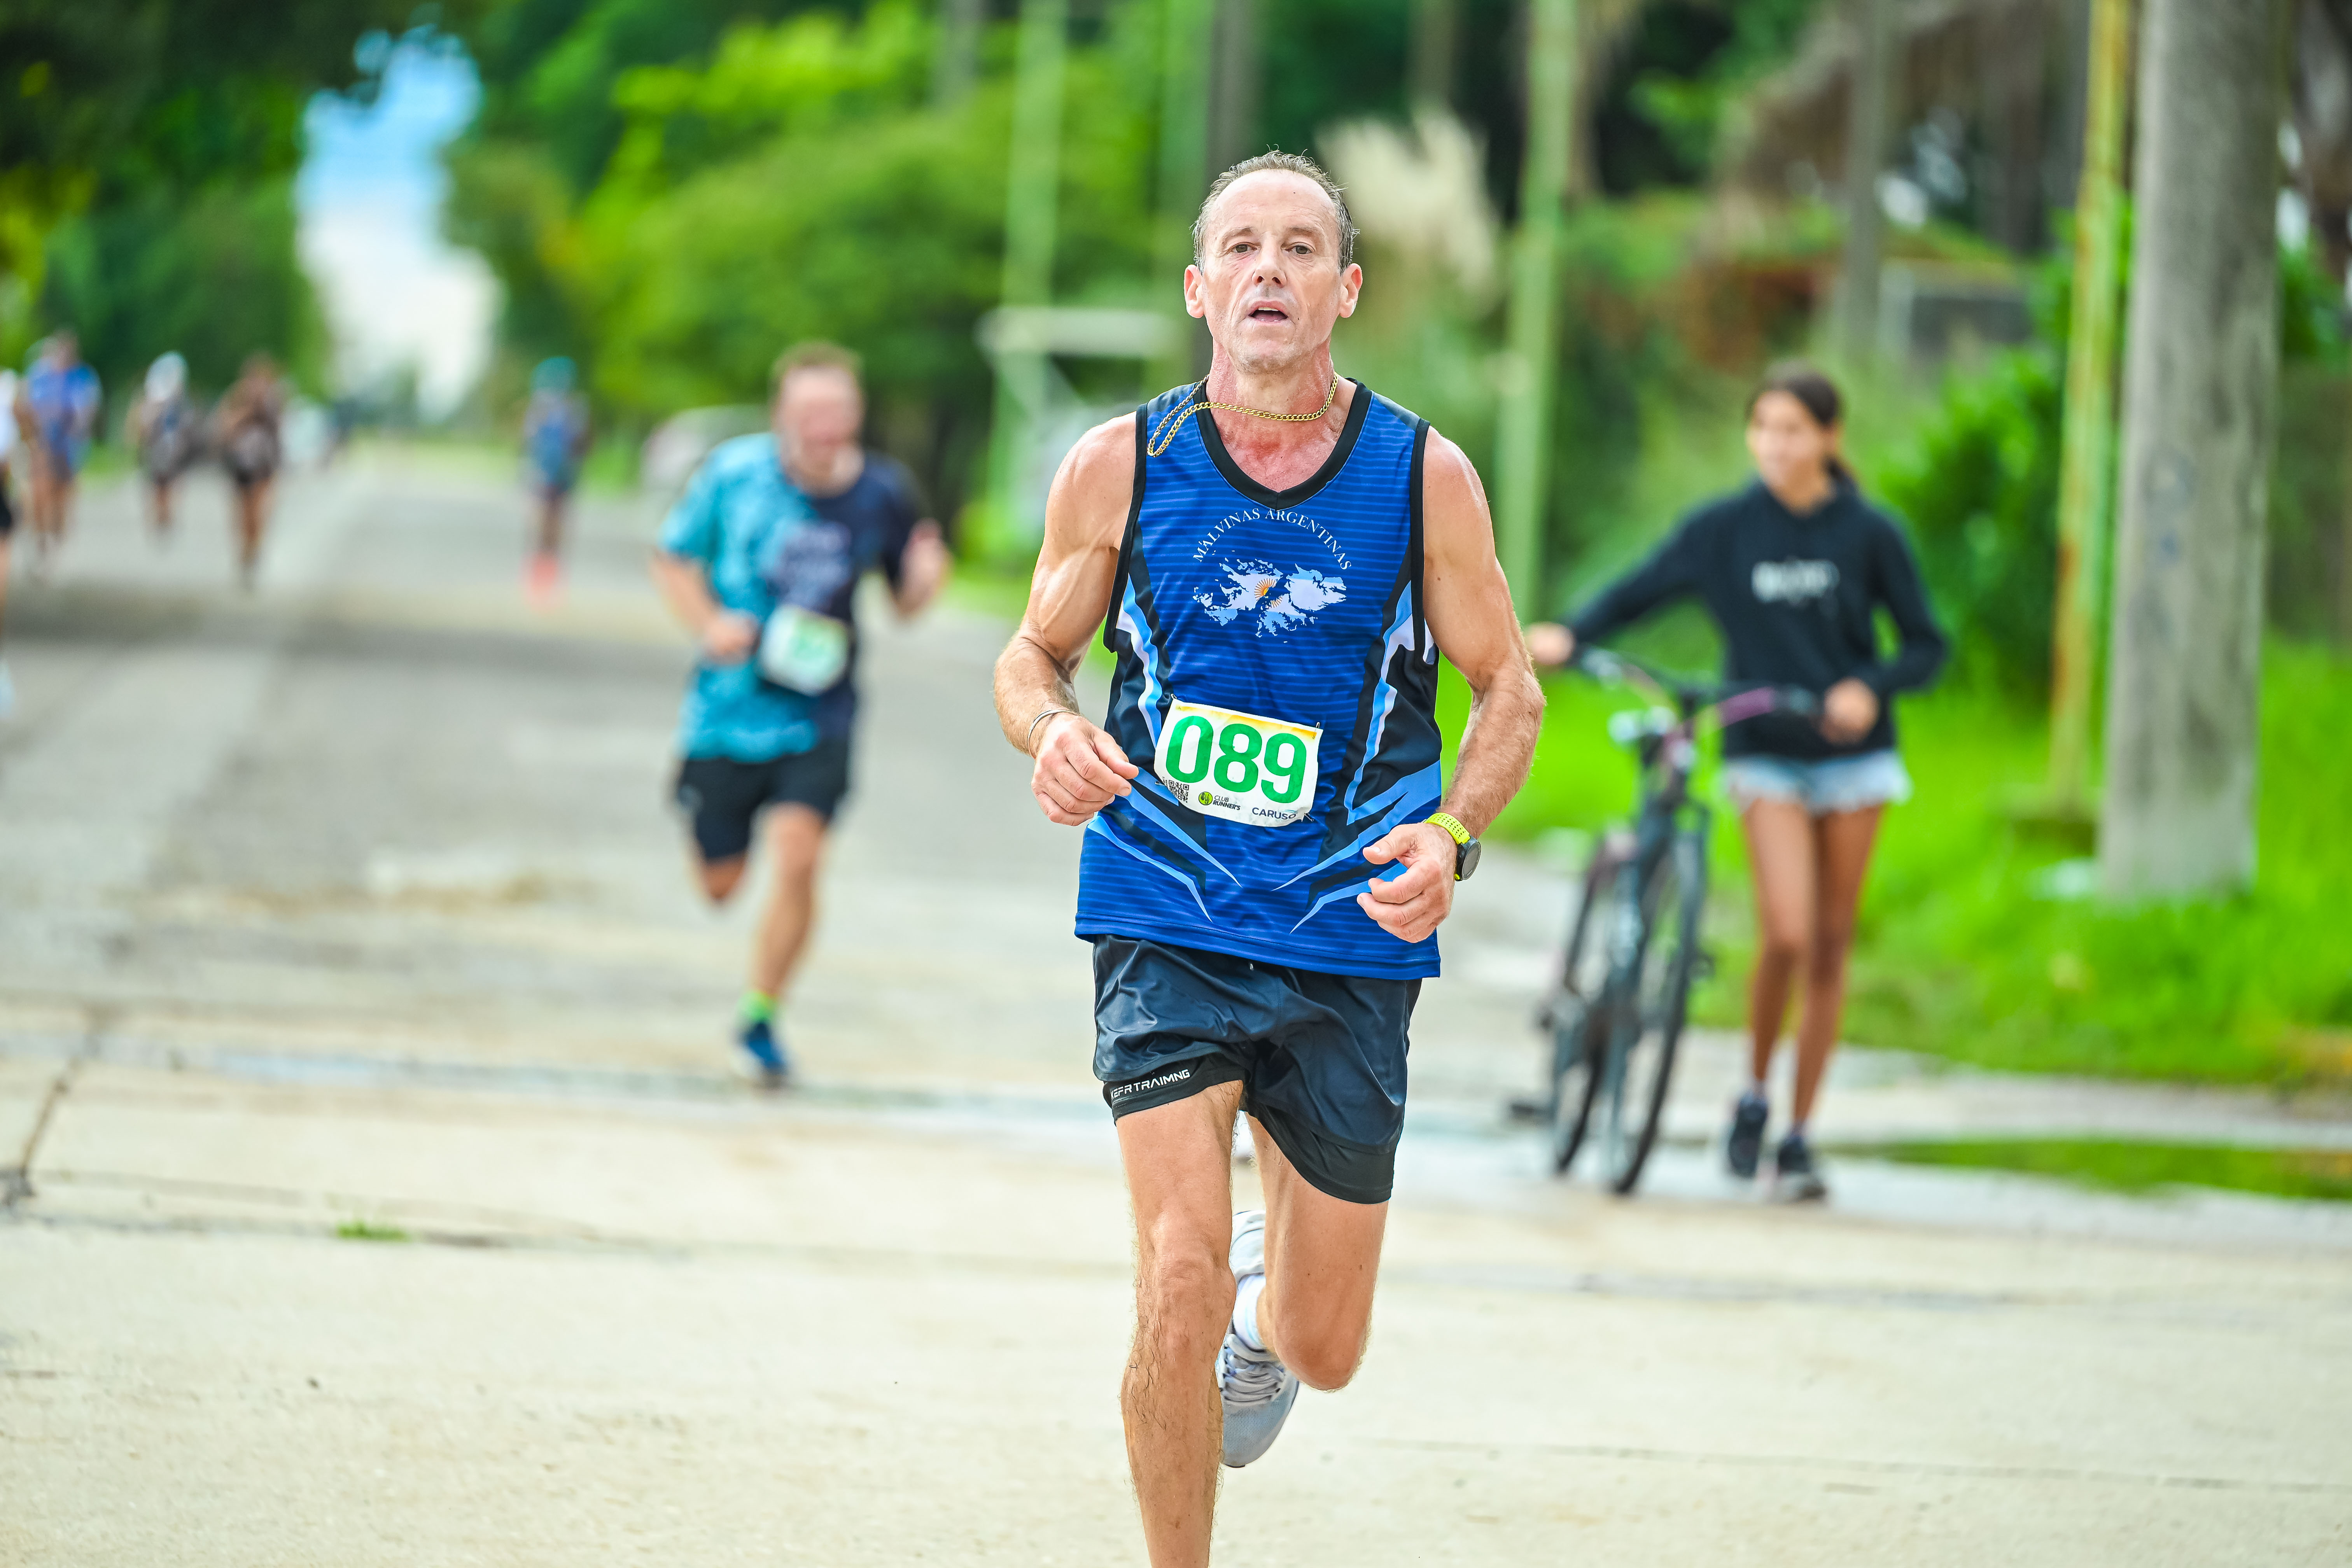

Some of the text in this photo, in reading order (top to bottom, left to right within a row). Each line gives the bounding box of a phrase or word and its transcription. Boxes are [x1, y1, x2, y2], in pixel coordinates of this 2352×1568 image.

[1193, 508, 1351, 570] MALVINAS ARGENTINAS
[1166, 716, 1306, 803] 089
[1213, 800, 1241, 810] RUNNER'S
[1252, 807, 1297, 820] CARUSO
